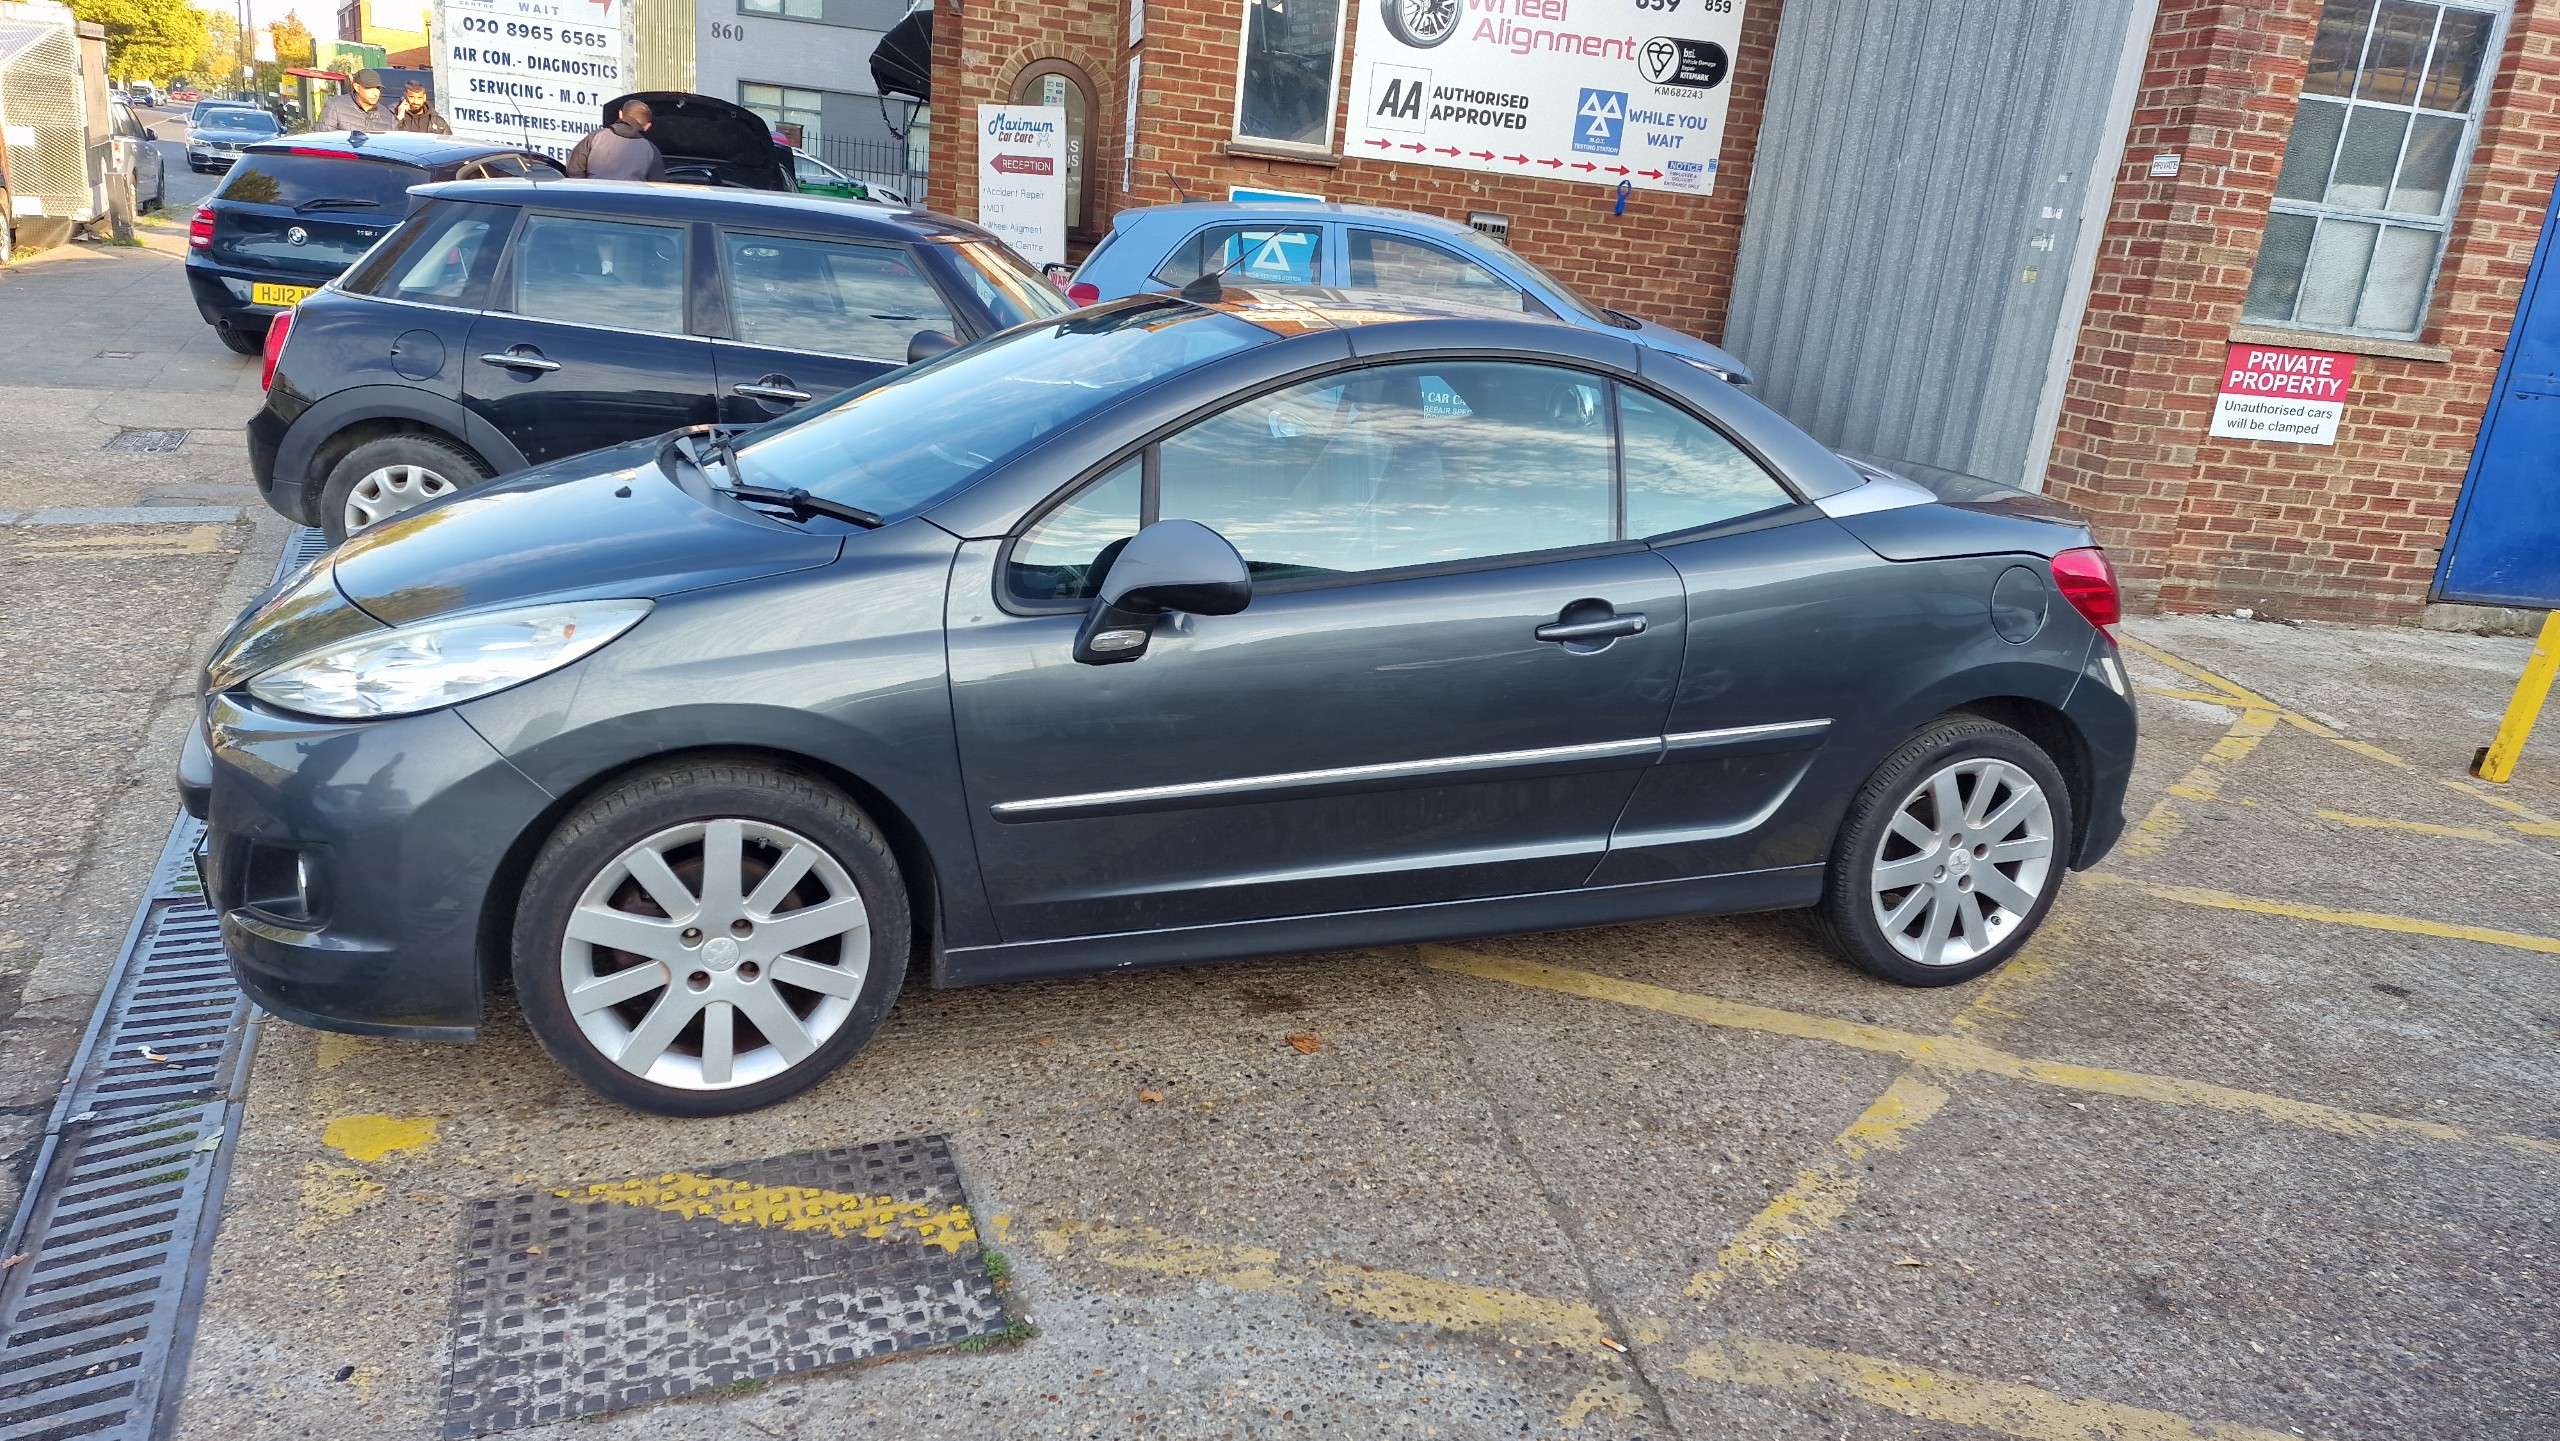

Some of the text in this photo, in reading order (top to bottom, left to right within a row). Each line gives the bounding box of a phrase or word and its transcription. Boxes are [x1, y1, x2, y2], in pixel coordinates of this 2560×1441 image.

[518, 2, 560, 16] WAIT
[1704, 0, 1732, 14] 859
[463, 16, 607, 48] 020 8965 6565
[711, 21, 744, 42] 860
[1471, 17, 1637, 61] Alignment
[453, 46, 477, 62] AIR
[527, 55, 618, 80] DIAGNOSTICS
[1680, 71, 1710, 82] KITEMARK
[469, 78, 544, 100] SERVICING
[559, 88, 604, 107] M.O.T.
[1376, 78, 1423, 120] AA
[1432, 86, 1529, 110] AUTHORISED
[1654, 86, 1703, 100] KM682243
[988, 112, 1054, 135] Maximum
[1429, 104, 1527, 130] APPROVED
[1628, 108, 1708, 131] WHILE YOU
[1647, 132, 1684, 149] WAIT
[1002, 159, 1051, 172] RECEPTION
[1669, 161, 1703, 173] NOTICE
[2152, 161, 2179, 170] PRIVATE
[986, 203, 1005, 213] MOT
[1015, 240, 1044, 252] Centre
[262, 286, 296, 304] HJ12
[2247, 351, 2335, 376] PRIVATE
[2228, 370, 2344, 397] PROPERTY
[1427, 391, 1450, 404] CAR
[1424, 405, 1451, 414] REPAIR
[2224, 400, 2333, 419] Unauthorised cars
[2227, 418, 2319, 435] will be clamped
